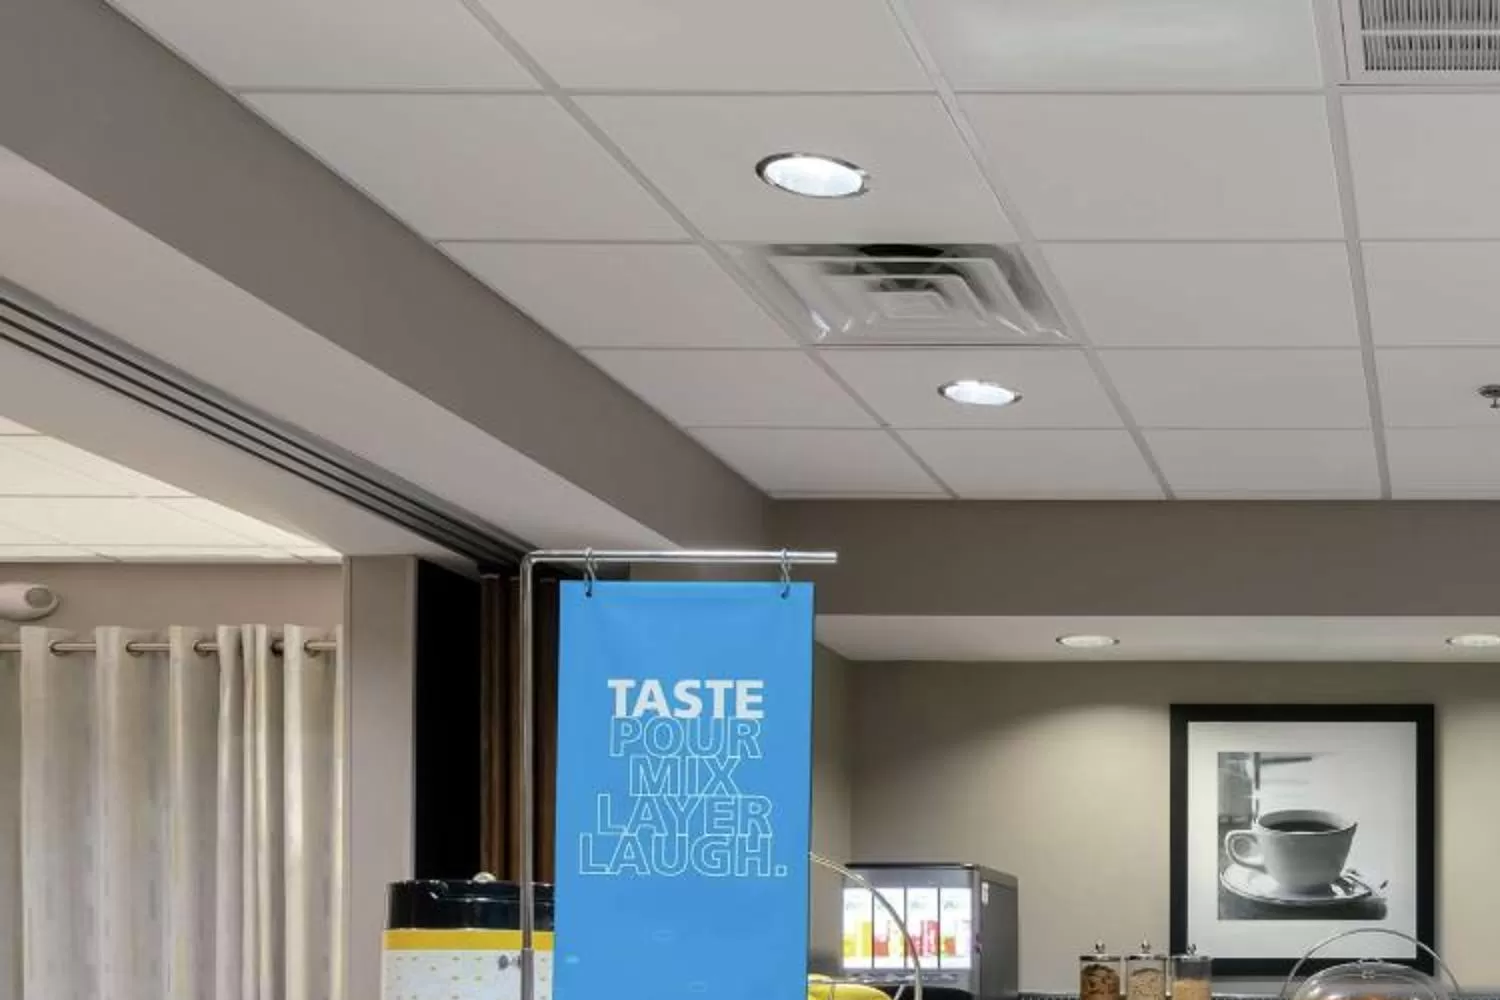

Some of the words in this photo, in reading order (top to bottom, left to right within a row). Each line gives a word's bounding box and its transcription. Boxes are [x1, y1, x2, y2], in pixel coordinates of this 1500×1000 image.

[607, 679, 764, 719] TASTE
[608, 715, 763, 759] POUR
[628, 754, 741, 797] MIX
[596, 792, 773, 837] LAYER
[577, 831, 788, 878] LAUGH.
